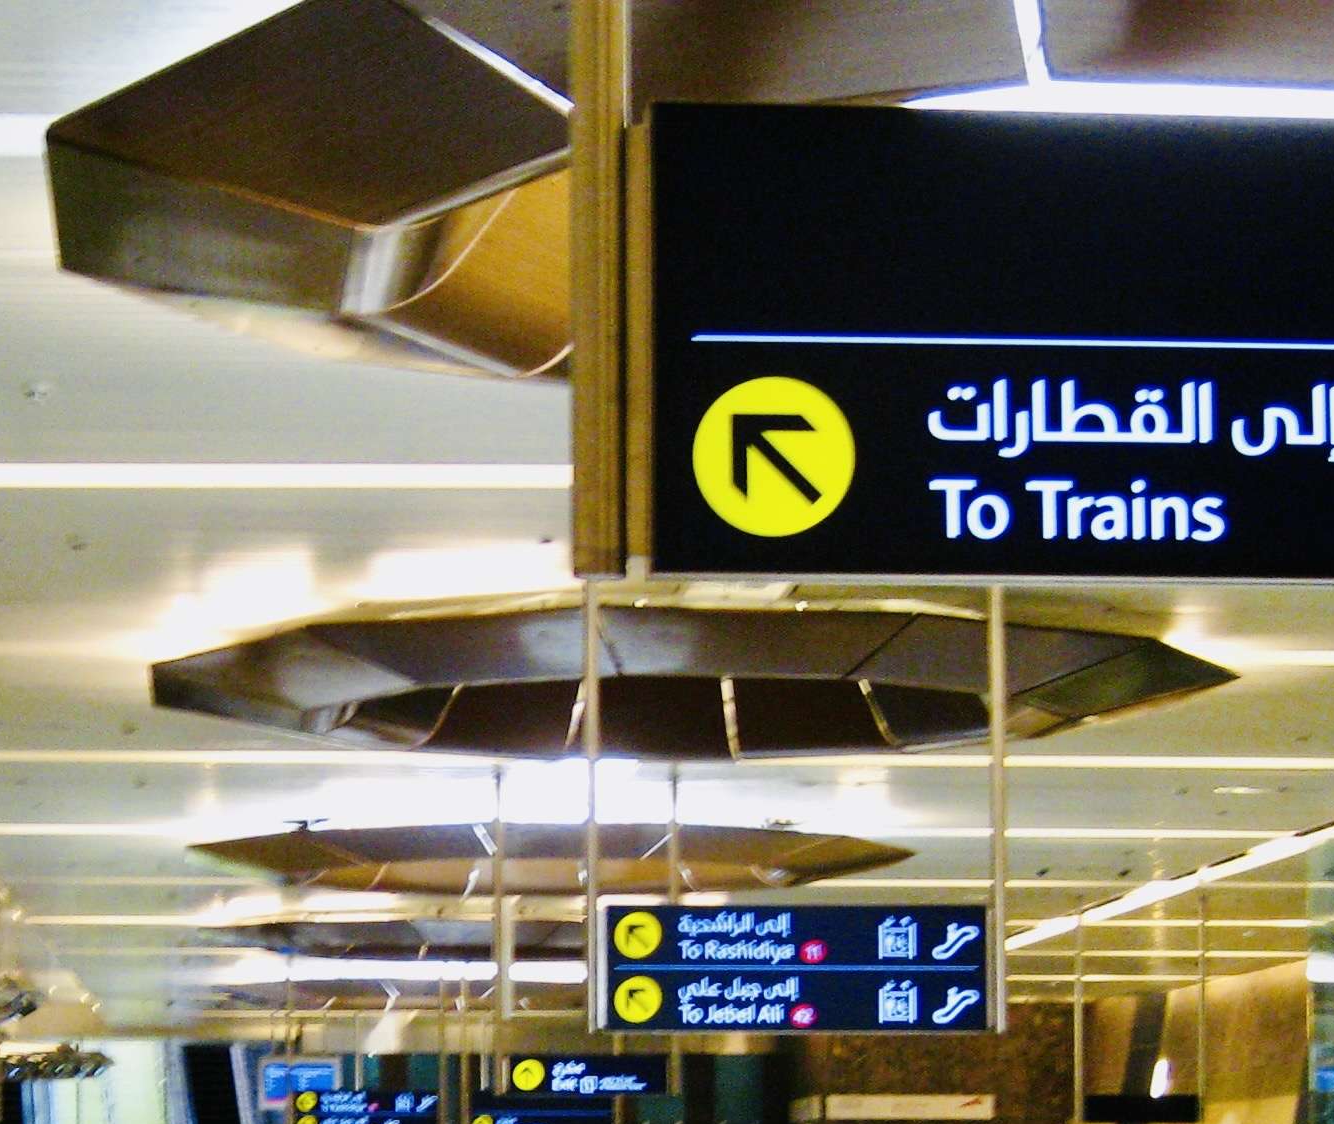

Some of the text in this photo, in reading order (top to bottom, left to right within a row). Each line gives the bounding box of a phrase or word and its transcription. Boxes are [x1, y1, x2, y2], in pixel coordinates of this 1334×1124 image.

[926, 378, 1214, 460] القطارات
[928, 477, 1228, 544] To Trains
[678, 939, 703, 960] To
[704, 939, 796, 965] Rashidiya
[678, 1003, 704, 1024] To
[704, 1003, 757, 1024] Jebel
[757, 1003, 785, 1024] Ali
